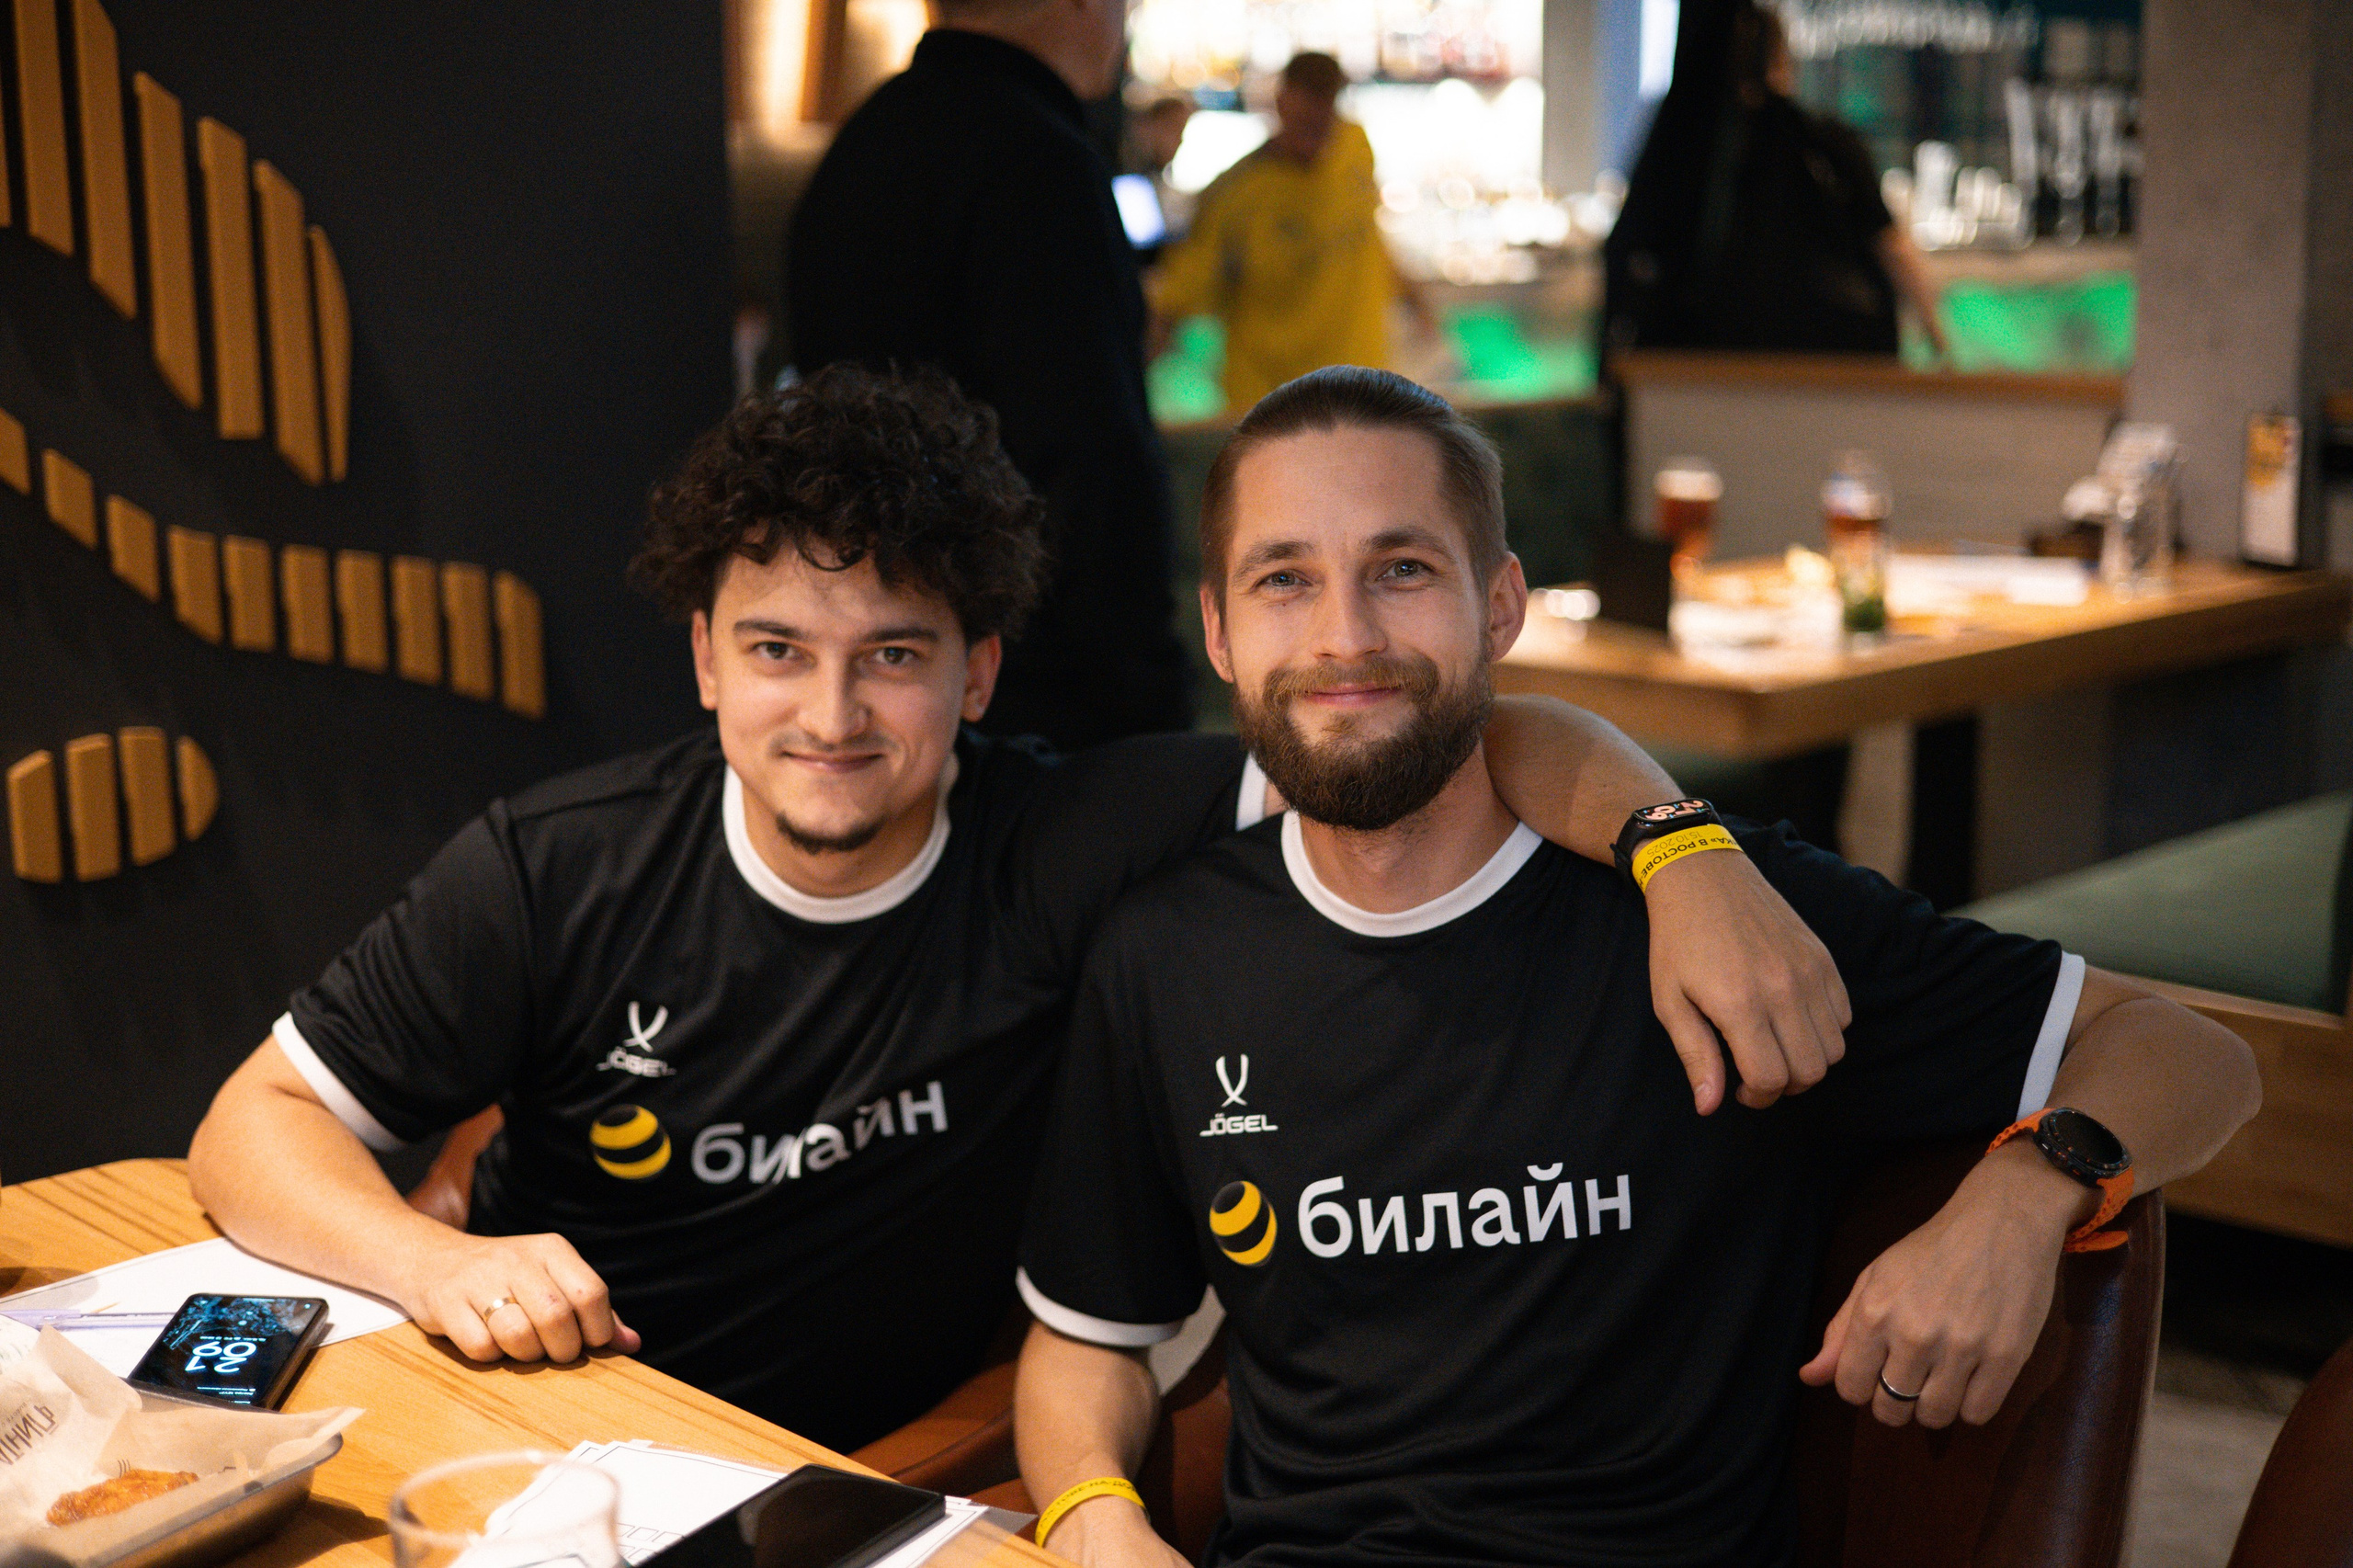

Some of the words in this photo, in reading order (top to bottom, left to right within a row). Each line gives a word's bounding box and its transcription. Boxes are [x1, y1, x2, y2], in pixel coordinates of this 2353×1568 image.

[1646, 831, 1702, 857] 15.10.2025
[1700, 838, 1709, 846] В
[1199, 1112, 1279, 1137] JÖGEL
[1297, 1162, 1631, 1258] билайн
[192, 1341, 256, 1358] 09
[185, 1356, 247, 1373] 21
